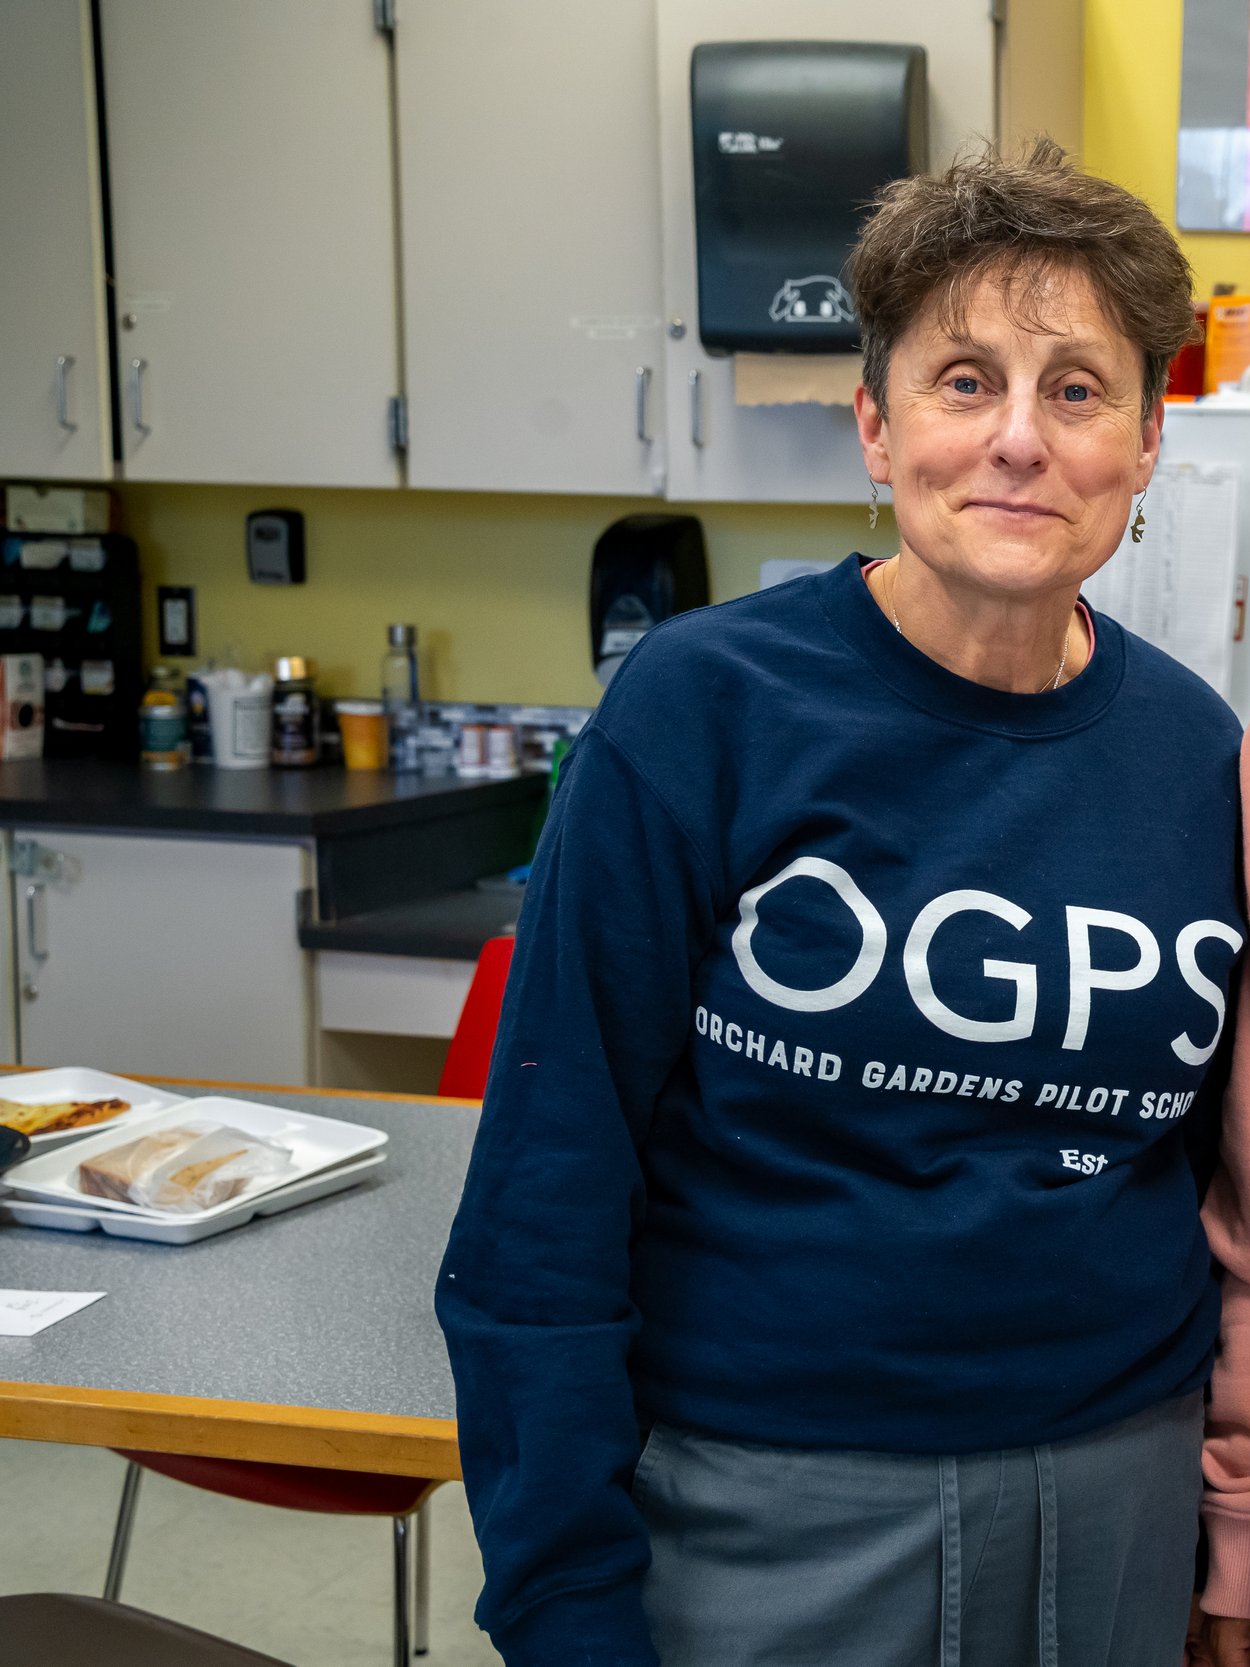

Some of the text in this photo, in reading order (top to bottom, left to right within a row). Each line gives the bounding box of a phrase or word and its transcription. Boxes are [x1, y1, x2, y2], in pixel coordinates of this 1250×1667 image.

[731, 856, 1244, 1066] OGPS
[695, 1005, 1197, 1120] ORCHARD GARDENS PILOT SCHO
